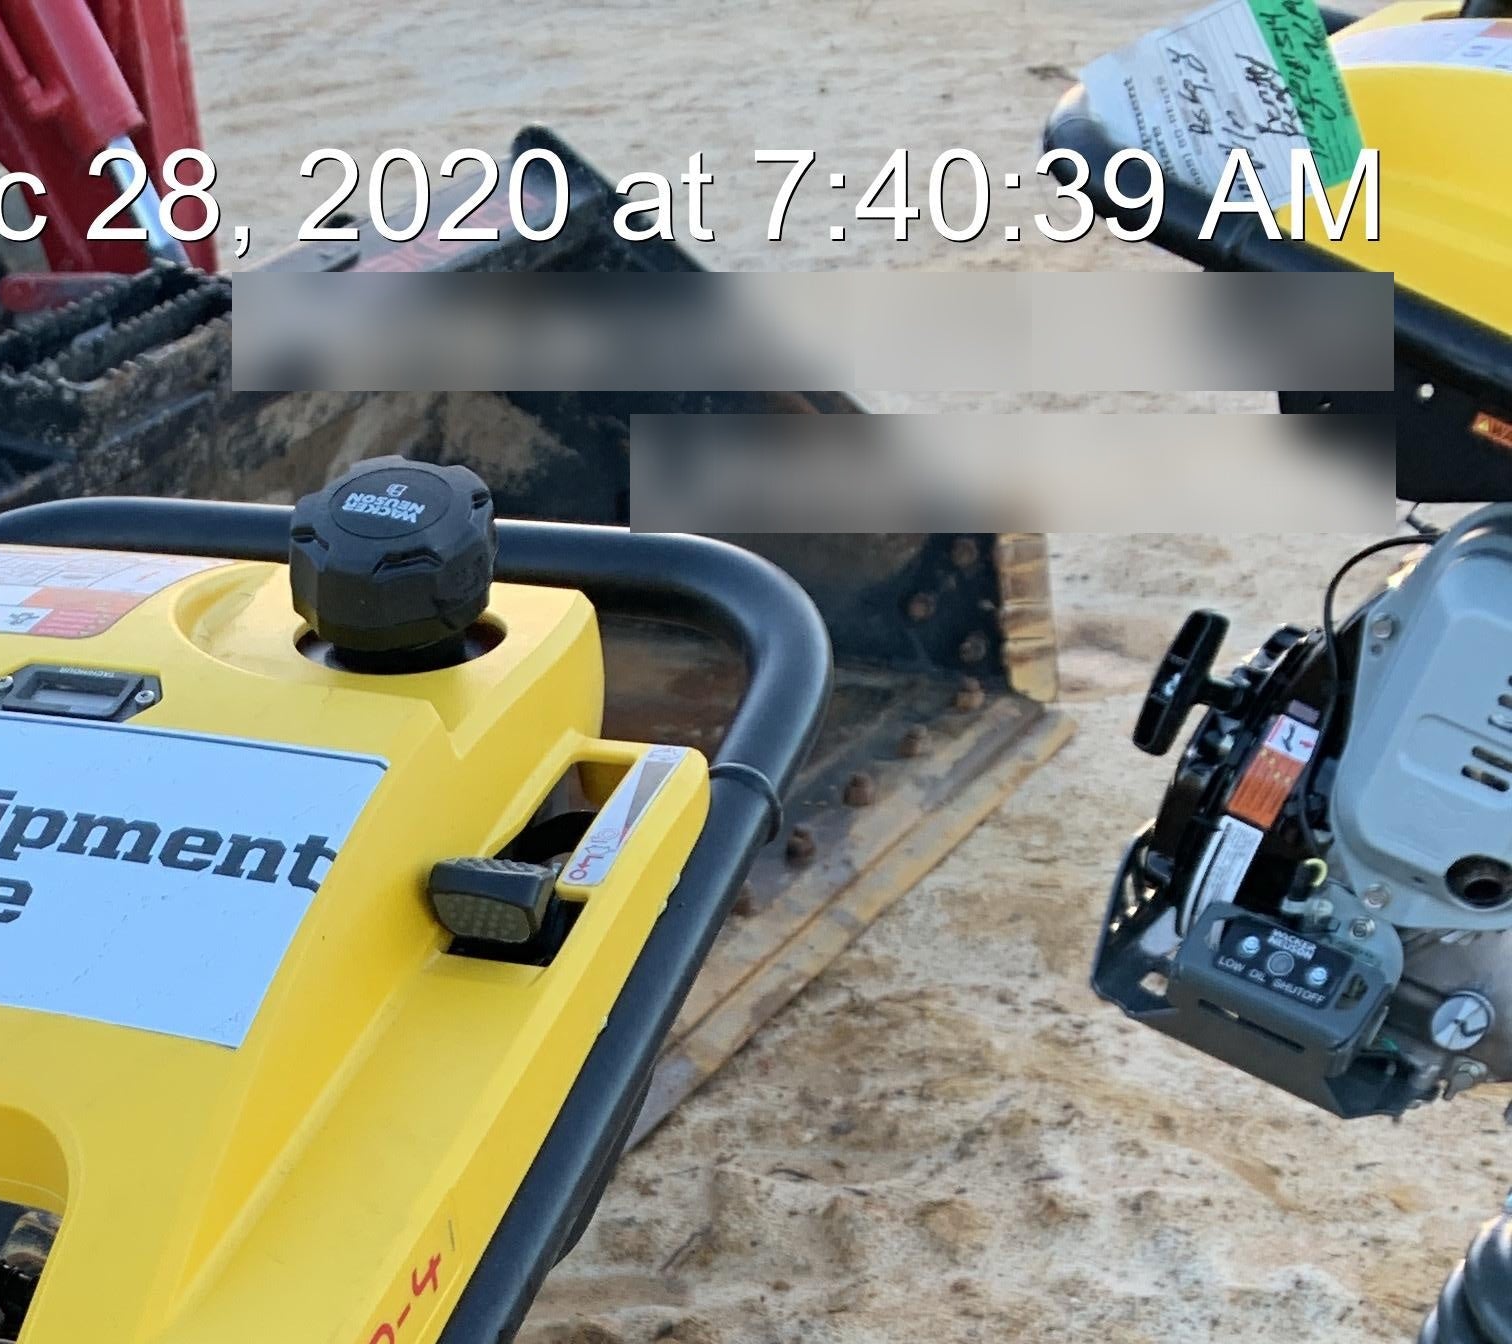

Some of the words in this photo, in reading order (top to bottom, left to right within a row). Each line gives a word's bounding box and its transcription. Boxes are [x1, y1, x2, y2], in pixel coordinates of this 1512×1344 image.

[342, 502, 417, 524] WACKER
[345, 492, 426, 514] NEUSON
[1219, 954, 1246, 973] LOW
[1272, 977, 1327, 1005] SHUTOFF
